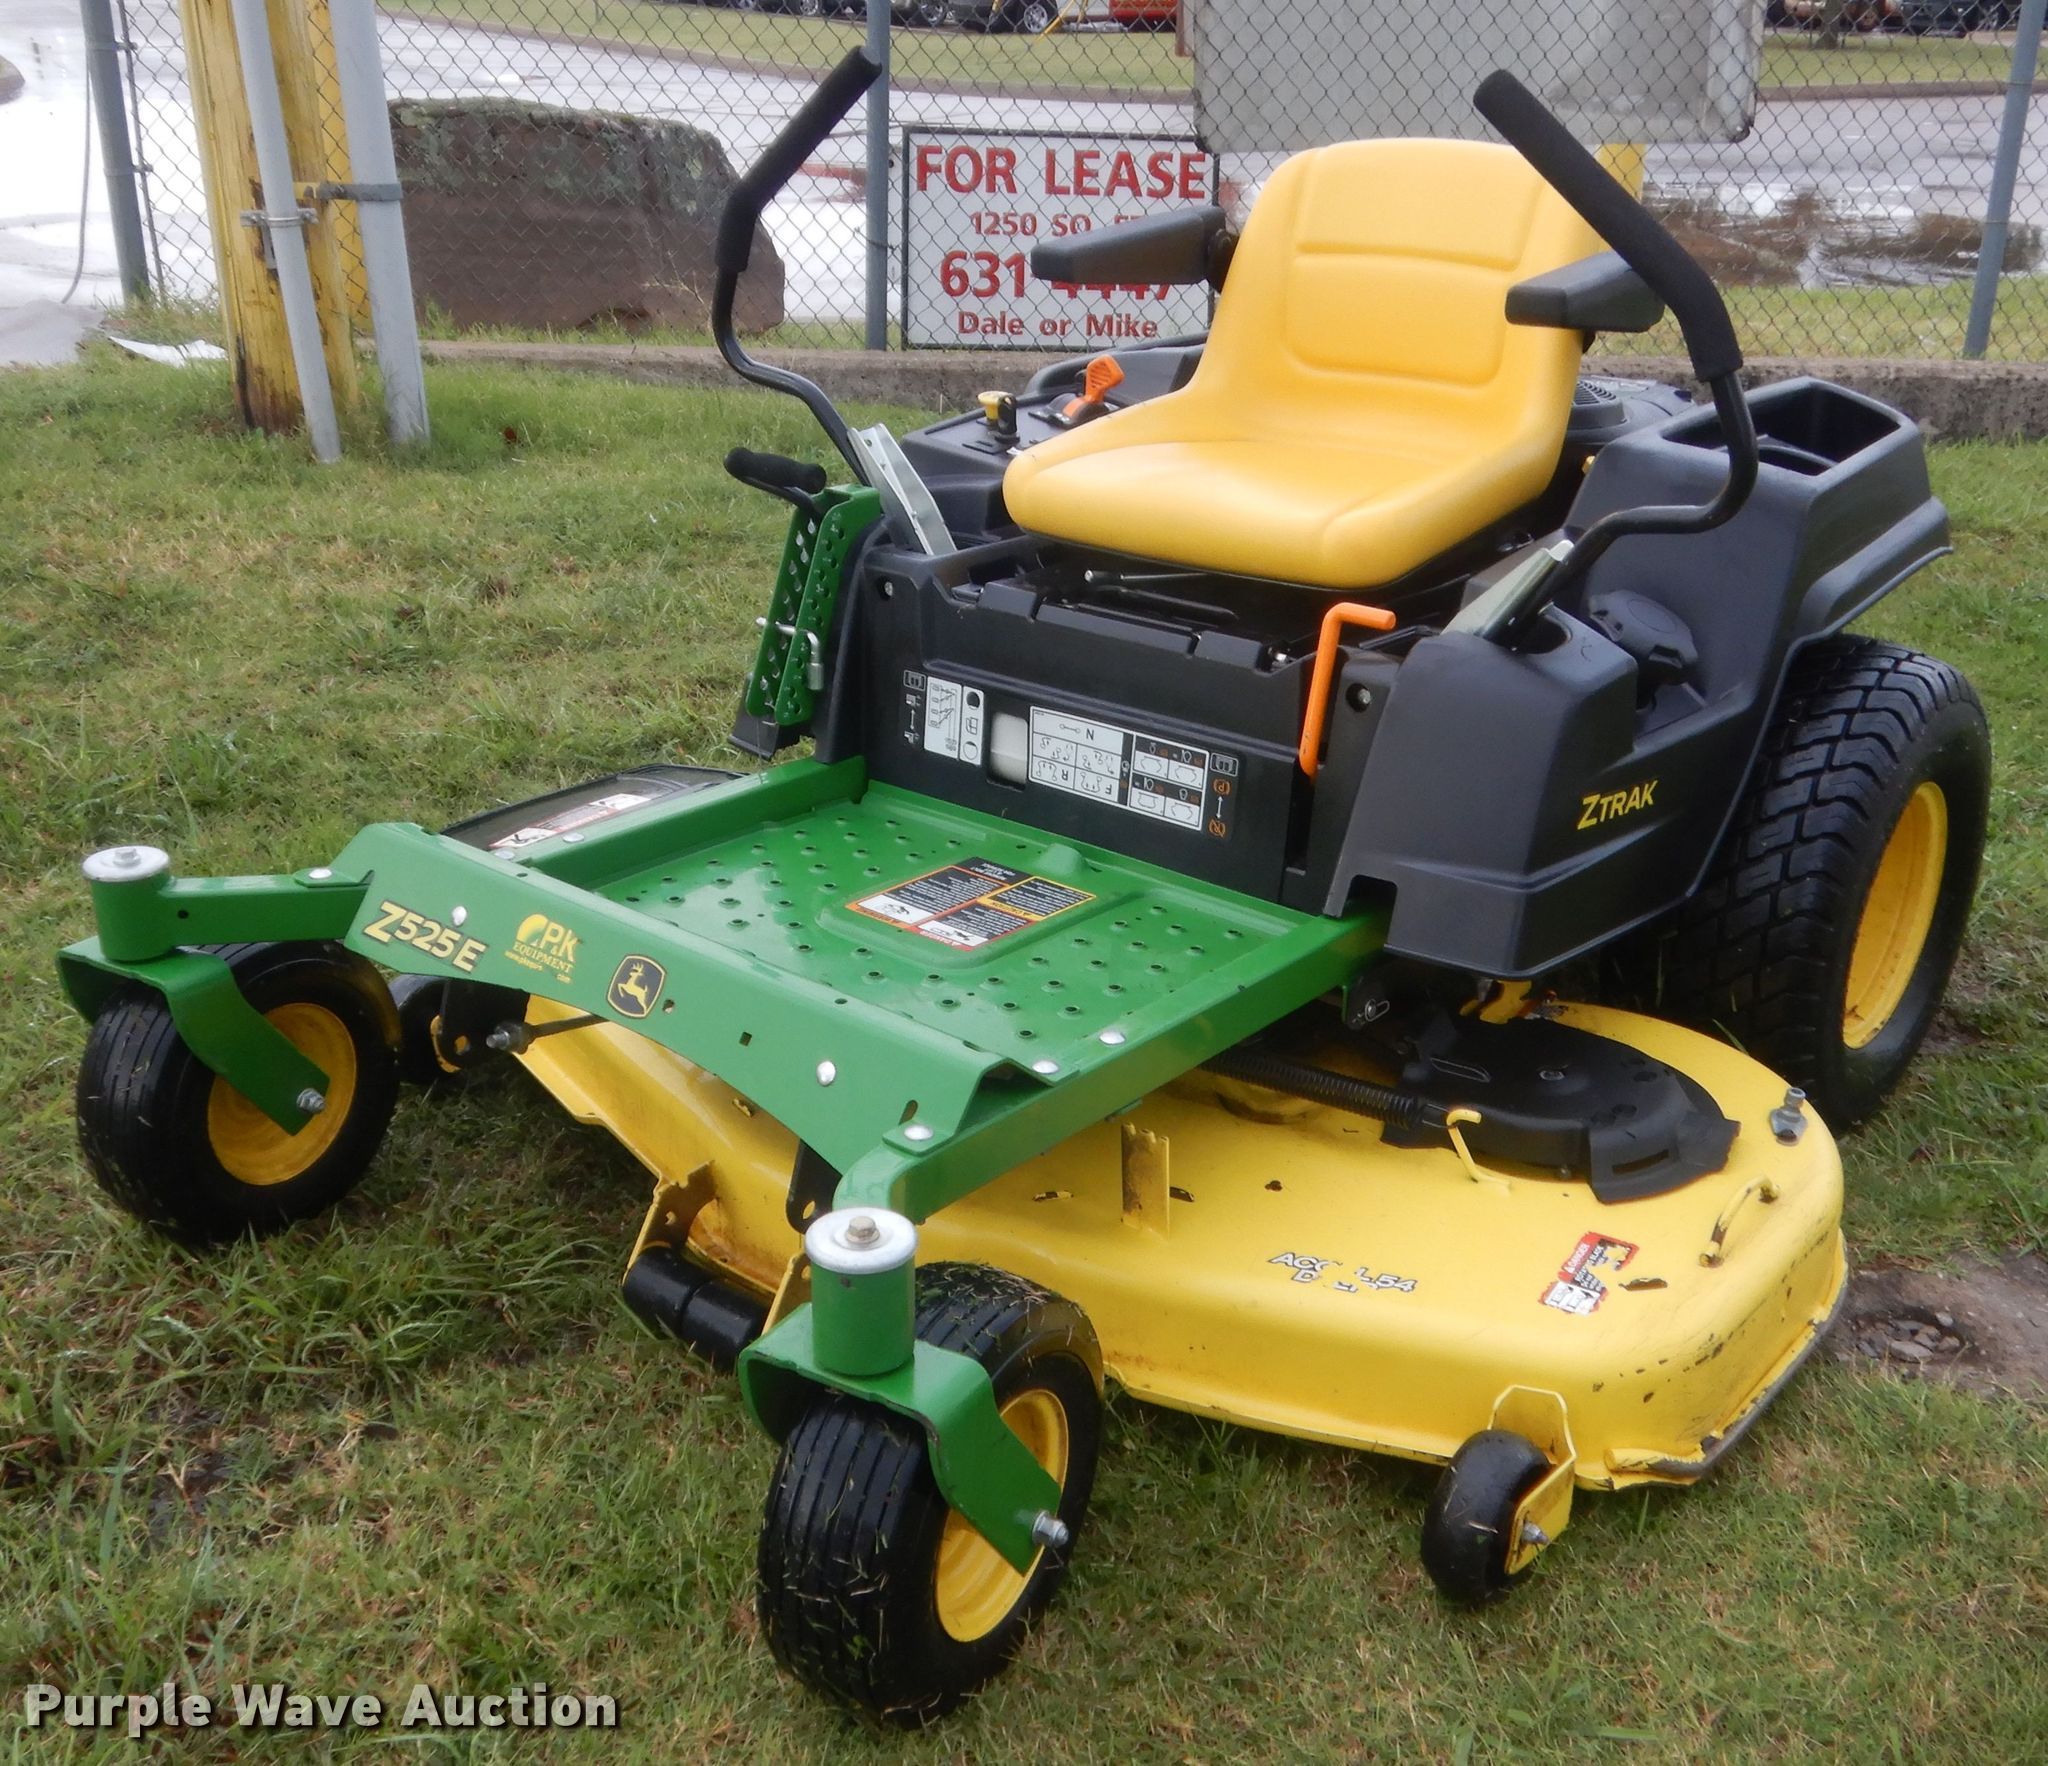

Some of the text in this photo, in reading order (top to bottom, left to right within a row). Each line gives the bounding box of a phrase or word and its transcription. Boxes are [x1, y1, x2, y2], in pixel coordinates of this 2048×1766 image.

[916, 144, 1207, 200] FOR LEASE
[970, 211, 1038, 238] 1250
[957, 310, 1159, 339] Dale or Mike
[1085, 727, 1095, 741] N
[1061, 768, 1069, 781] R
[1104, 783, 1112, 795] F
[1577, 780, 1658, 830] ZTRAK
[362, 899, 489, 974] Z525E
[512, 941, 574, 974] EQUIPMENT
